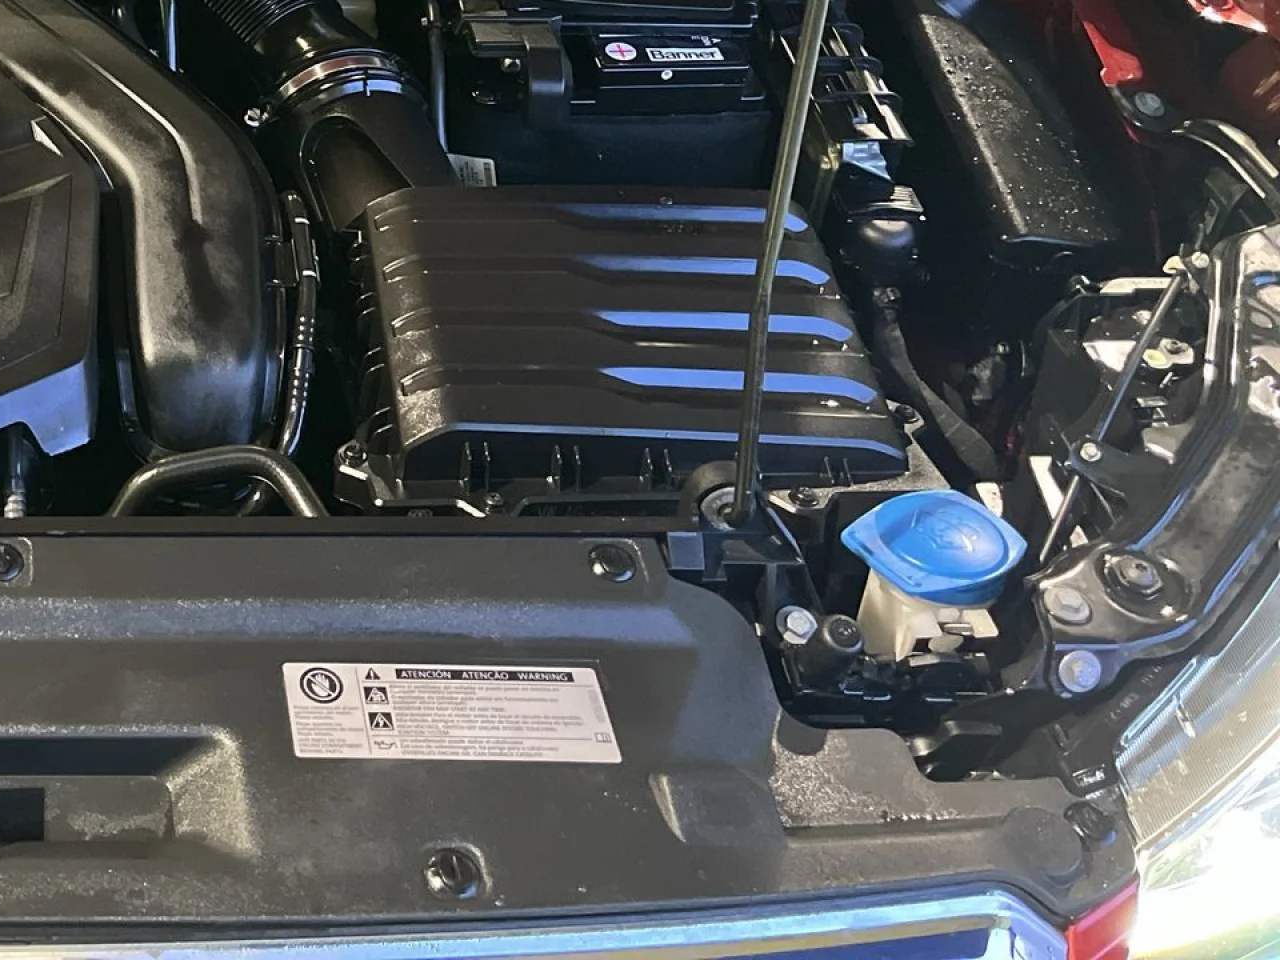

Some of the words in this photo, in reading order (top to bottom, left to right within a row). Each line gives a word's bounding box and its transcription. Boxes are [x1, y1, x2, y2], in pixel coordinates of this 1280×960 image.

[650, 50, 718, 60] Banner
[401, 669, 451, 679] ATENCIÓN
[517, 671, 569, 681] WARNING
